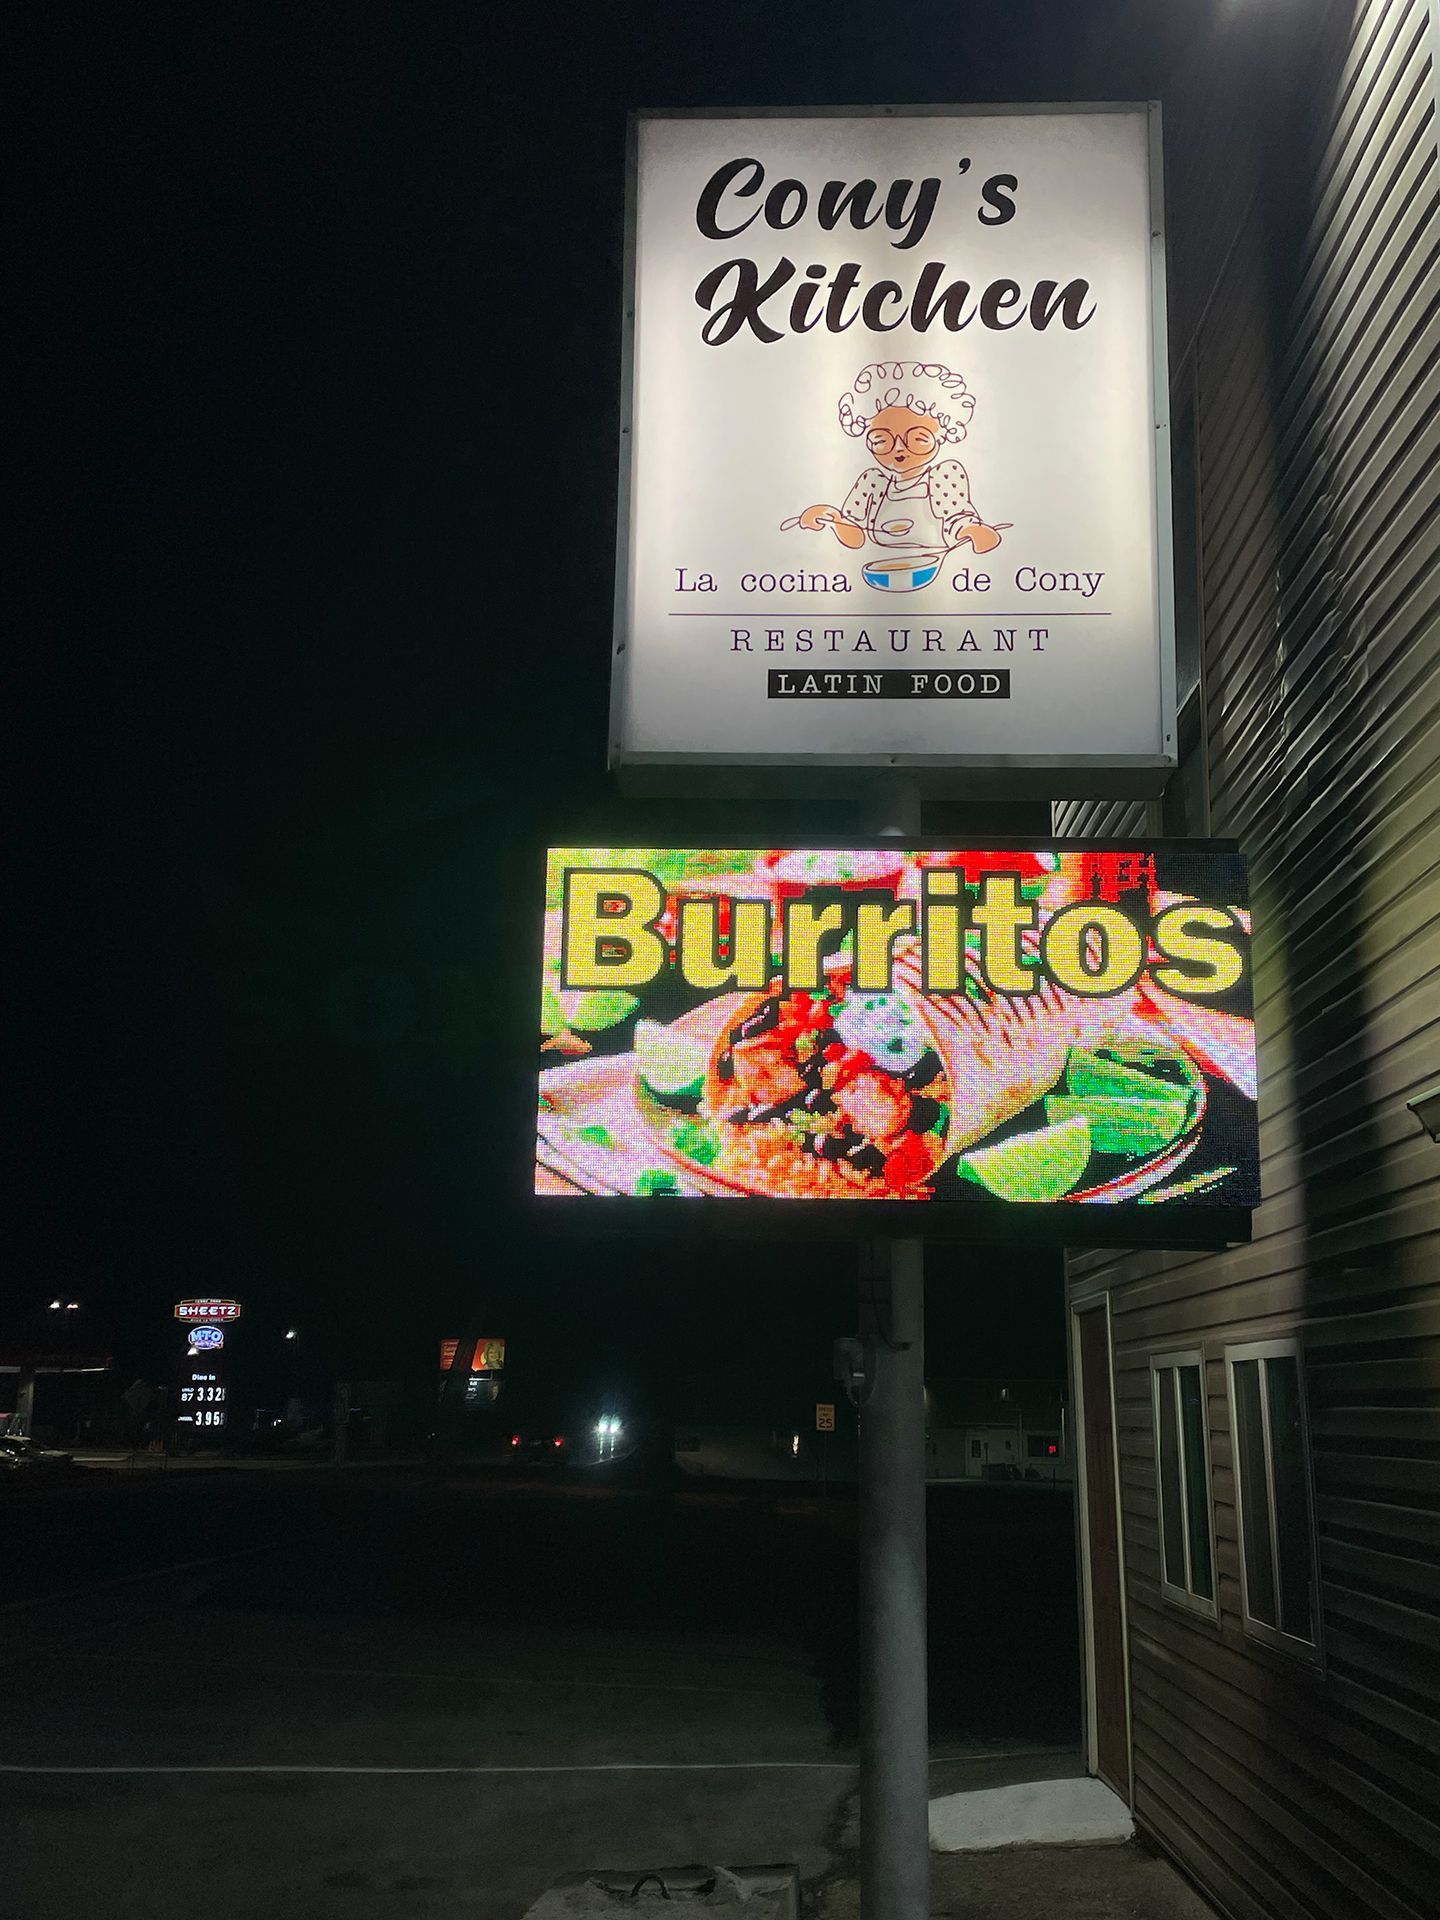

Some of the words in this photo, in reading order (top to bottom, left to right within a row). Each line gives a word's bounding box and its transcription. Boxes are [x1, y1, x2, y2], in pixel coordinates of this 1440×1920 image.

[696, 157, 1018, 250] Cony's
[695, 256, 1098, 347] Kitchen
[674, 568, 718, 593] La
[740, 568, 852, 594] cocina
[952, 568, 991, 593] de
[1015, 567, 1106, 599] Cony
[730, 629, 1050, 653] RESTAURANT
[778, 674, 883, 694] LATIN
[911, 674, 1001, 694] FOOD
[564, 869, 1244, 996] Burritos
[179, 1306, 236, 1316] SHEETZ
[181, 1393, 194, 1402] 87
[819, 1418, 833, 1428] 25
